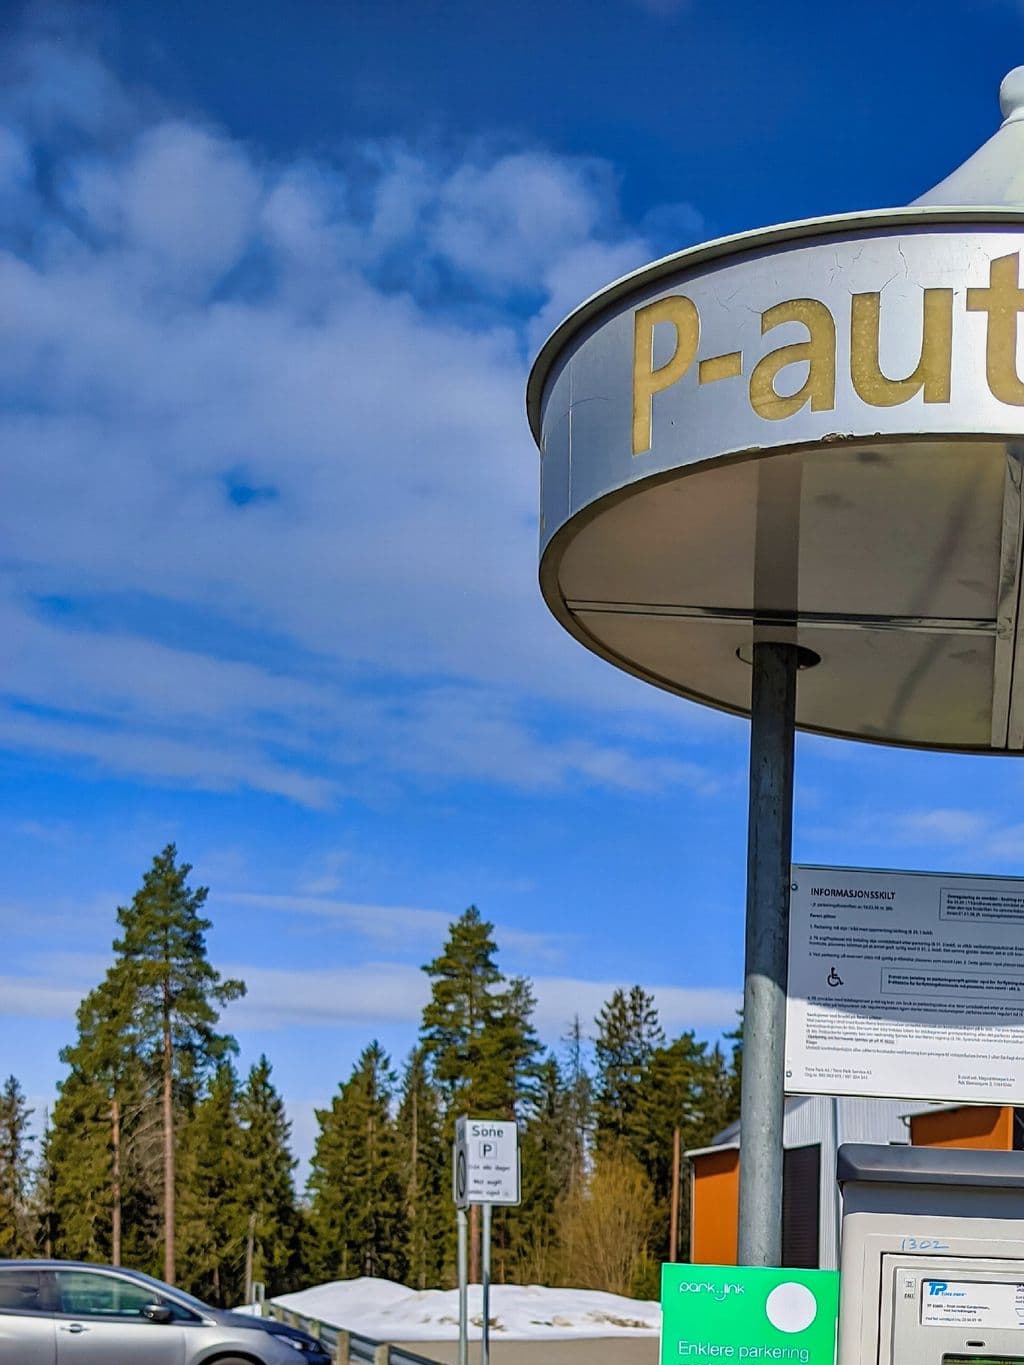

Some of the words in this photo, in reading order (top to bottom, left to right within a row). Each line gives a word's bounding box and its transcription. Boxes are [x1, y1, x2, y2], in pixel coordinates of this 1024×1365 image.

[810, 887, 896, 900] INFORMASJONSSKILT
[472, 1125, 504, 1138] Sone
[483, 1143, 493, 1158] P
[901, 1239, 950, 1251] 1302
[678, 1340, 735, 1357] Enklere
[739, 1344, 809, 1363] parkering
